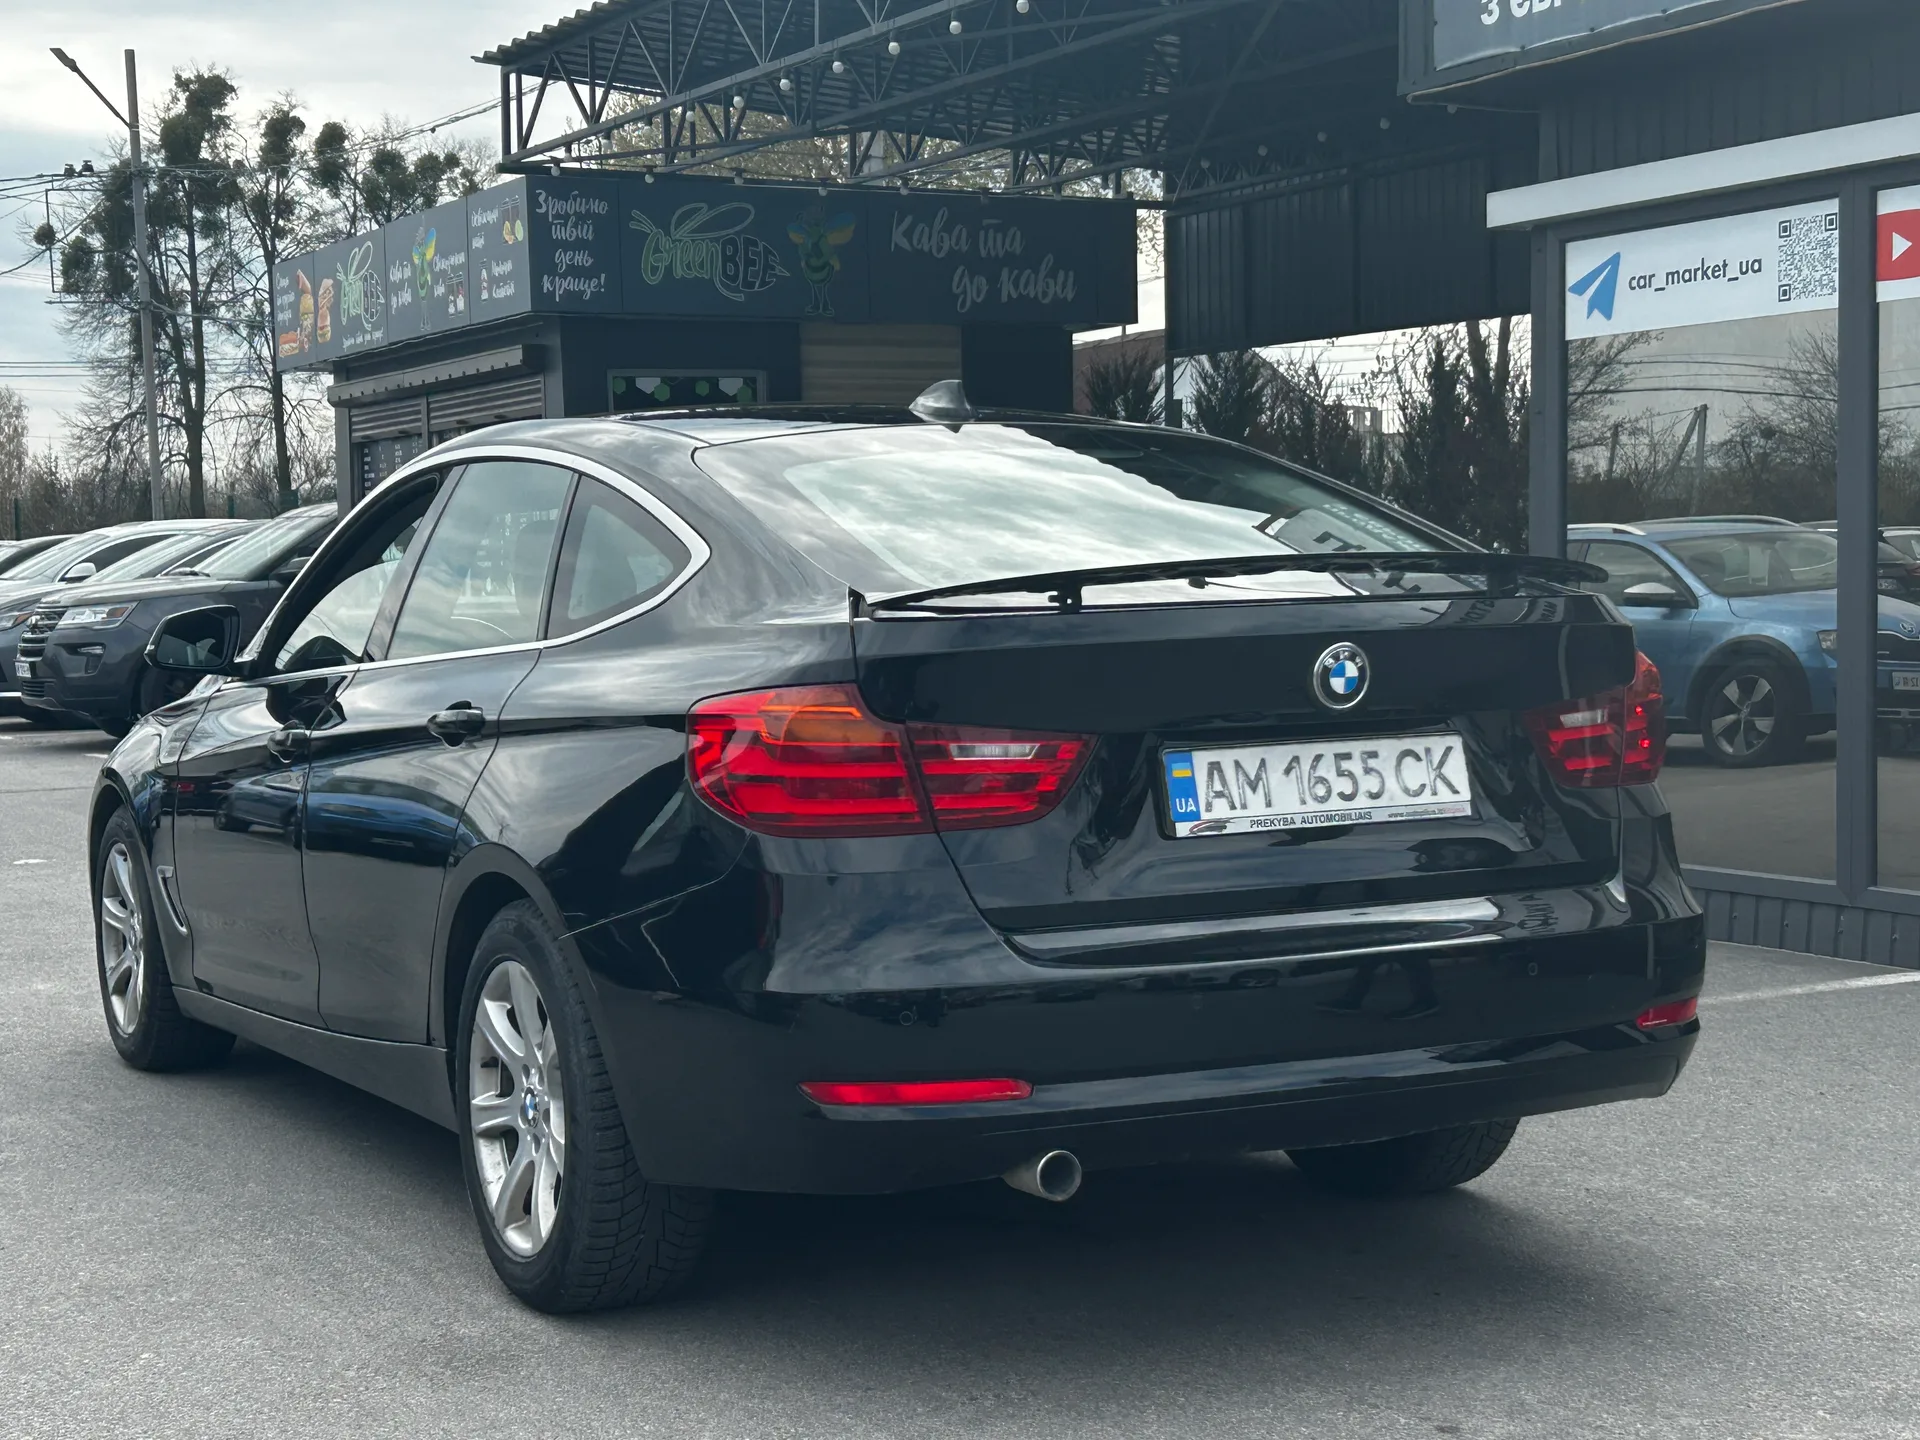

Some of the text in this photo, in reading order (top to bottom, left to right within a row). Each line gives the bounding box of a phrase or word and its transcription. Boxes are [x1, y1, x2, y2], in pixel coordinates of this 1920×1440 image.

[551, 215, 595, 241] твій
[890, 206, 1026, 259] Кава та
[554, 248, 594, 273] день
[1628, 257, 1763, 292] car_market_ua
[541, 273, 606, 302] краще!
[952, 253, 1078, 313] до кави
[1205, 745, 1461, 813] AM 1655 CK
[1175, 797, 1197, 813] UA
[1250, 814, 1297, 829] PREKYBA
